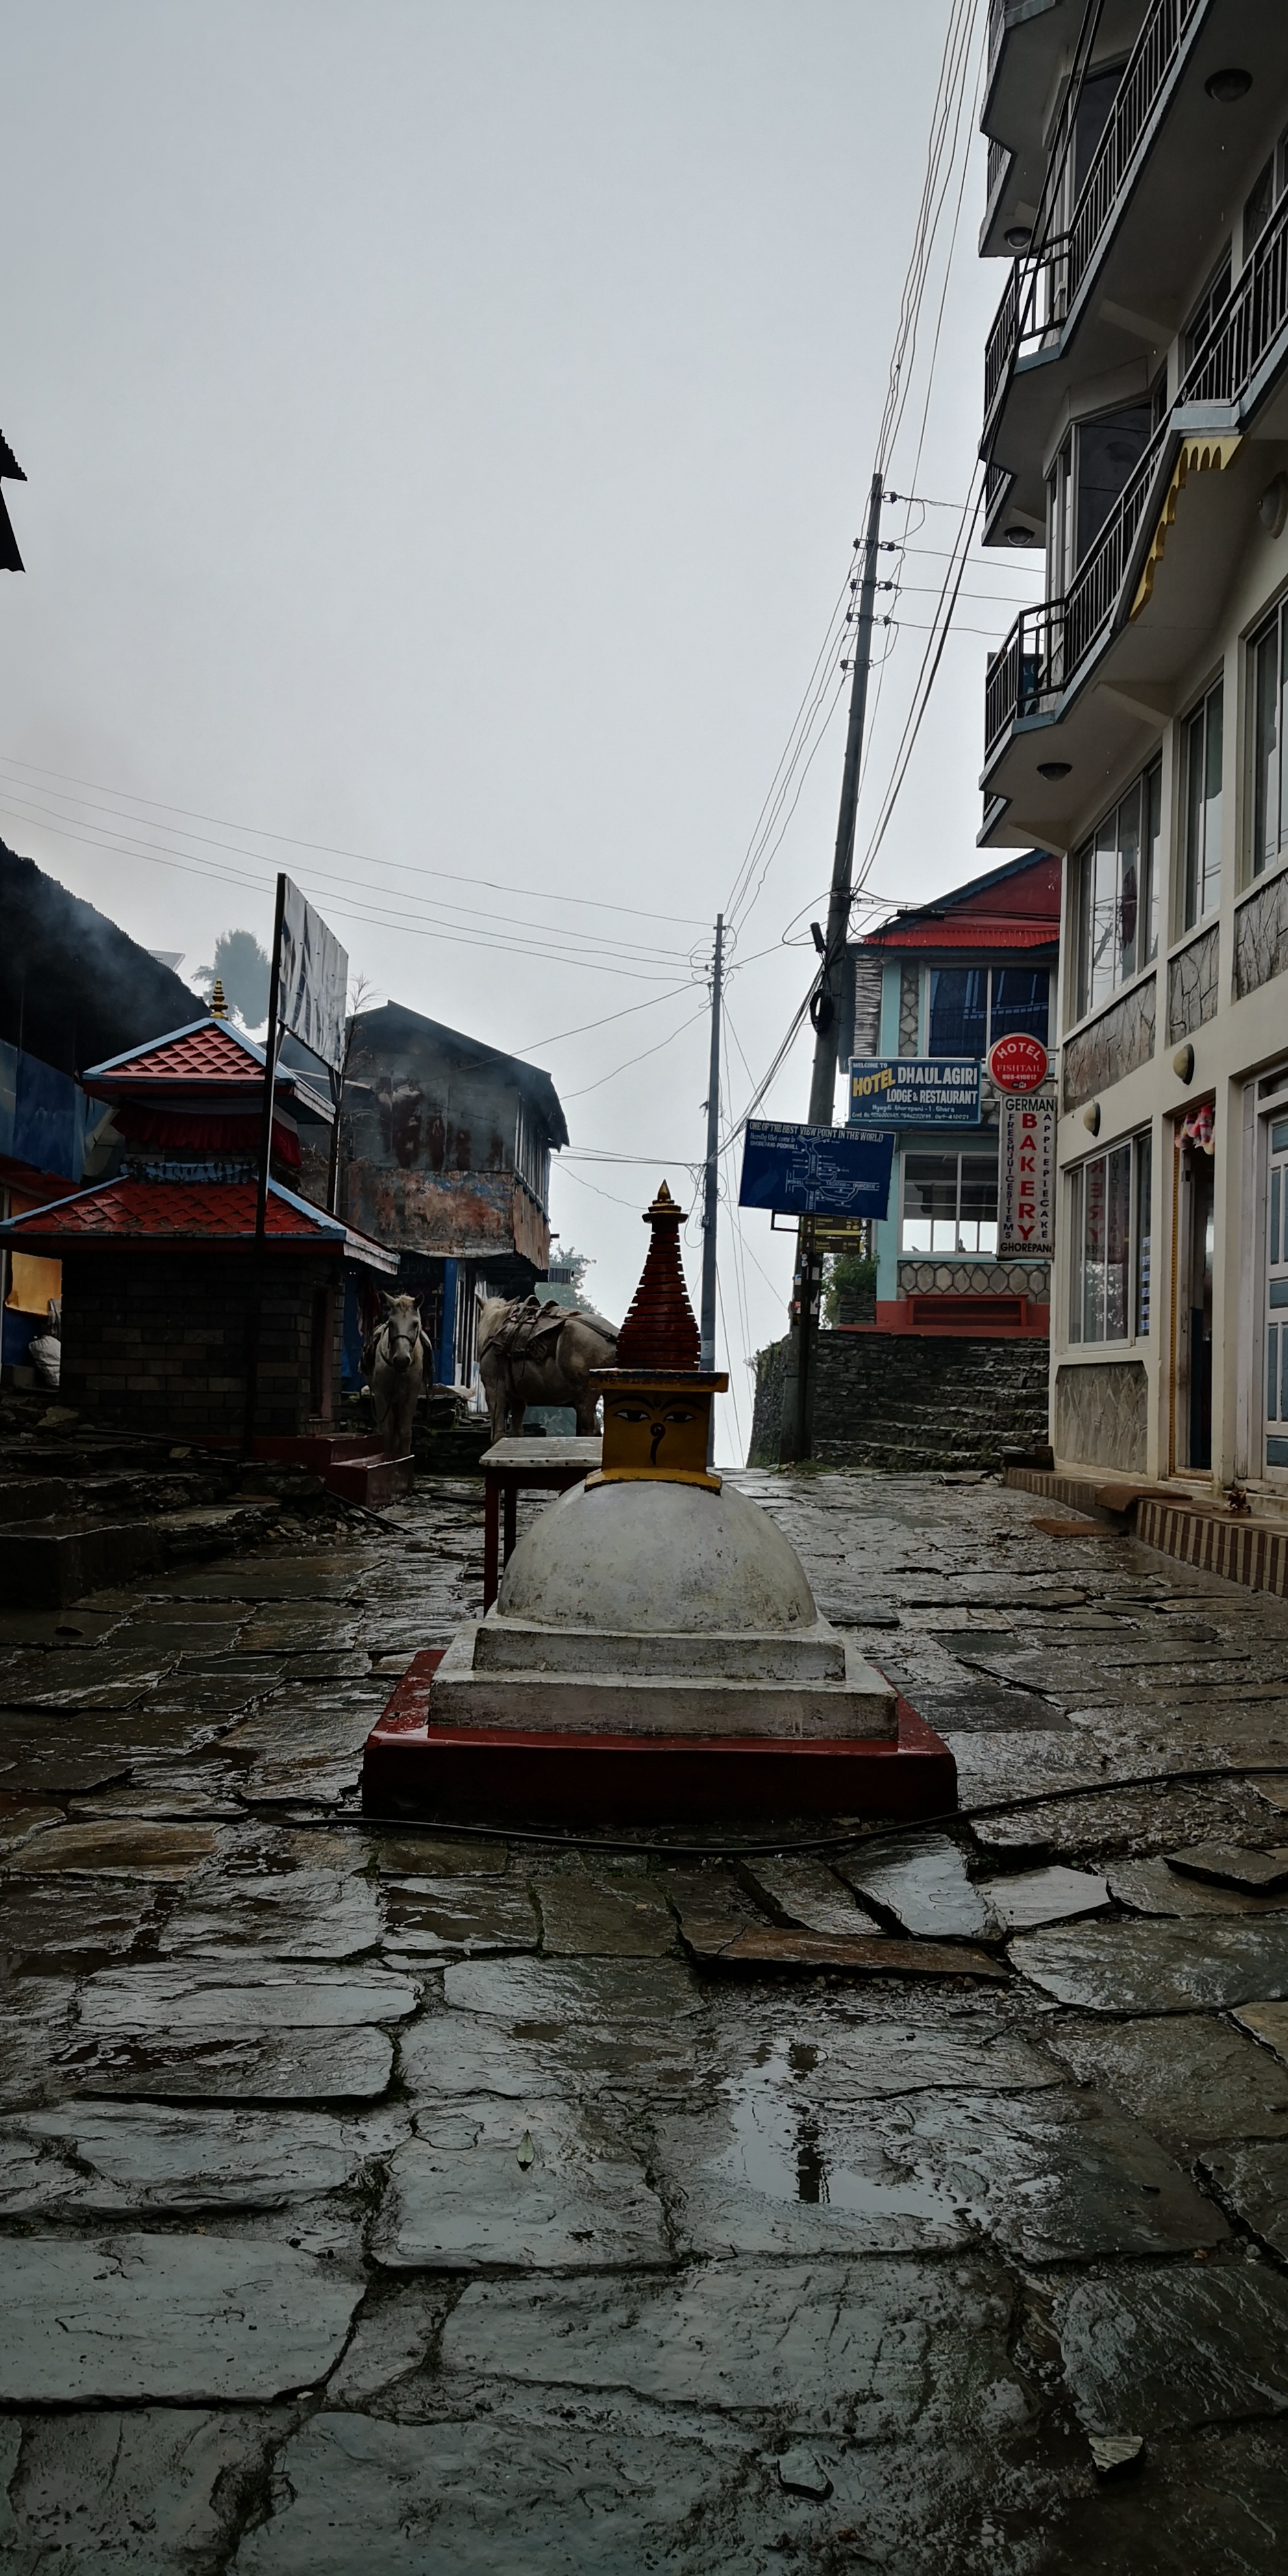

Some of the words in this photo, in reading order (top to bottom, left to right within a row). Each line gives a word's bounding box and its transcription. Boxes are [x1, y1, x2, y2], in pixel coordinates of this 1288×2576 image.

[996, 1042, 1041, 1061] HOTEL
[852, 1068, 896, 1097] HOTEL
[897, 1067, 978, 1085] DHAULAGIRI
[886, 1089, 913, 1103] LODGE
[913, 1093, 919, 1102] &
[919, 1090, 978, 1105] RESTAURANT
[1006, 1098, 1054, 1111] GERMAN
[749, 1122, 762, 1131] ONE
[762, 1123, 770, 1132] OF
[771, 1124, 782, 1133] THE
[782, 1124, 799, 1134] BEST
[800, 1126, 817, 1136] VIEW
[817, 1128, 837, 1139] POINT
[838, 1130, 845, 1139] IN
[845, 1131, 859, 1141] THE
[860, 1132, 884, 1143] WORLD
[1017, 1113, 1037, 1241] BAKERY
